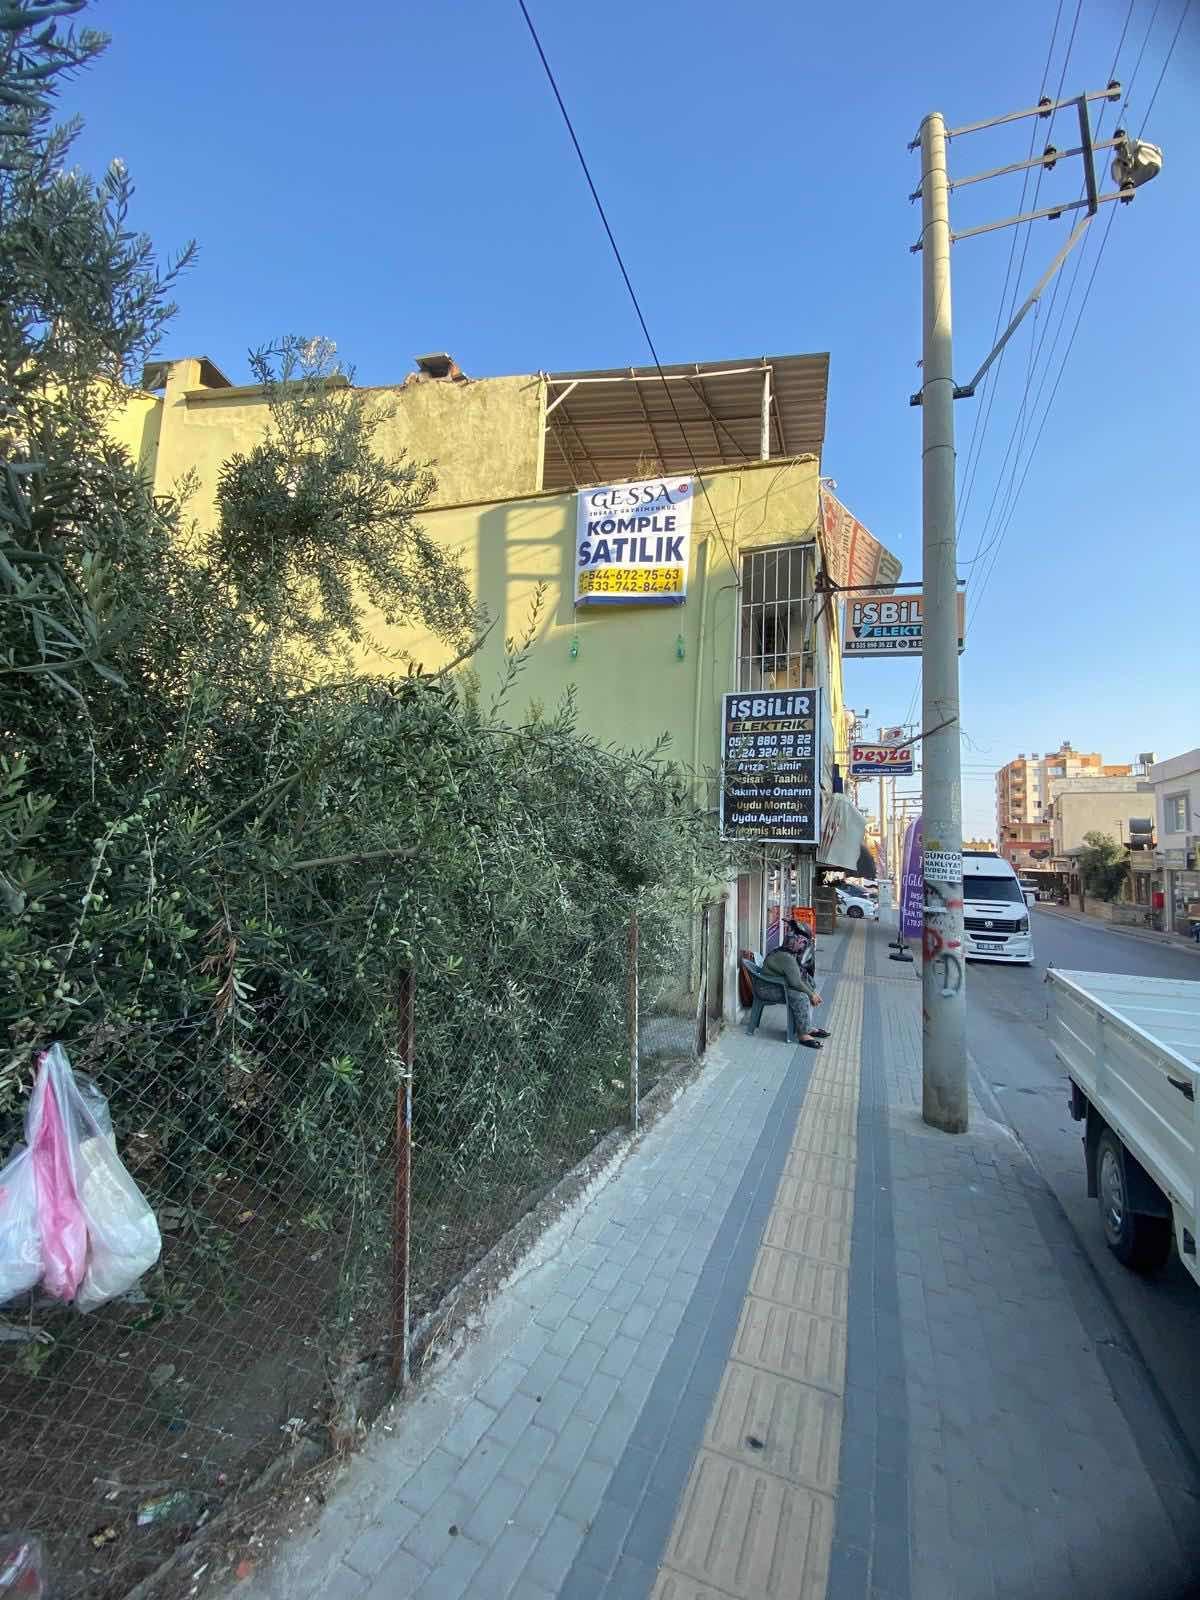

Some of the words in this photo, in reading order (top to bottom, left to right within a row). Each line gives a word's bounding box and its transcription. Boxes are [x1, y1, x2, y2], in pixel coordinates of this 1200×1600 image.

[591, 483, 676, 509] GESSA
[587, 515, 676, 537] KOMPLE
[578, 536, 685, 566] SATILIK
[797, 734, 812, 744] 22
[796, 746, 811, 757] 02
[760, 788, 771, 796] ve
[732, 813, 757, 824] Uydu
